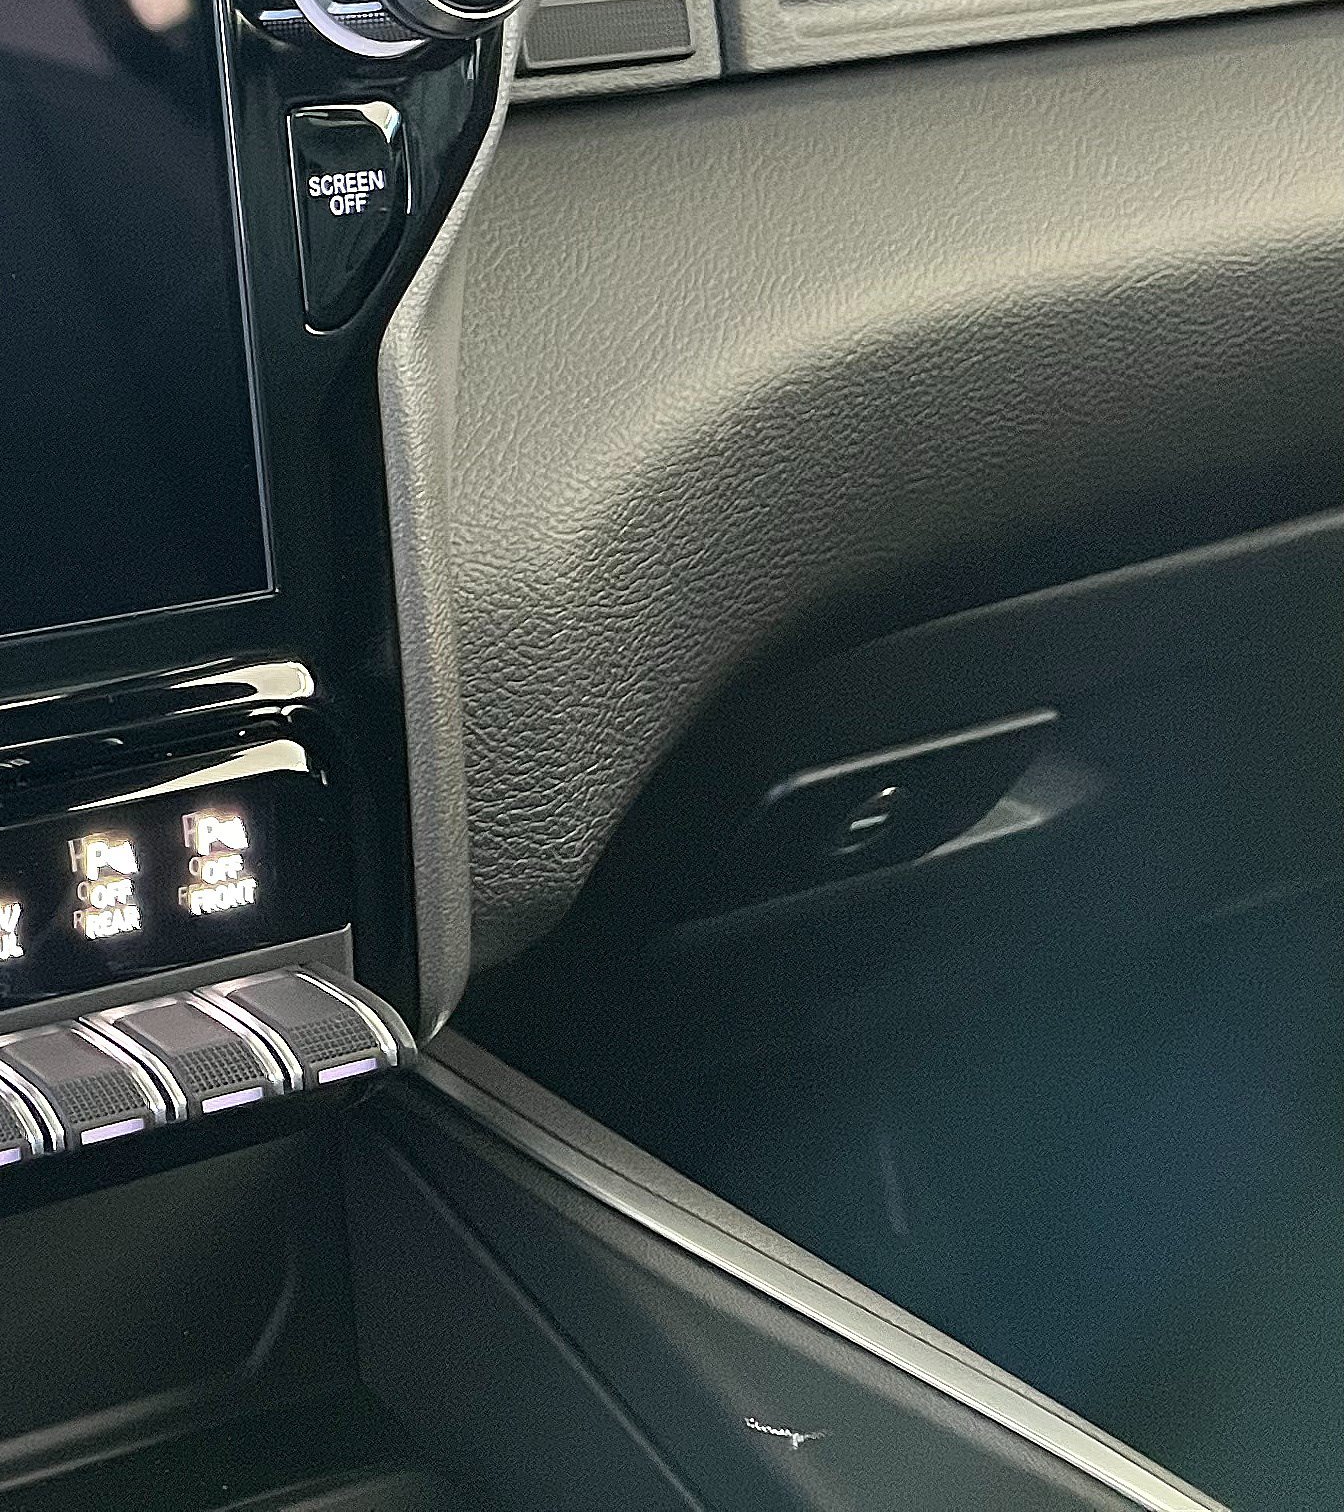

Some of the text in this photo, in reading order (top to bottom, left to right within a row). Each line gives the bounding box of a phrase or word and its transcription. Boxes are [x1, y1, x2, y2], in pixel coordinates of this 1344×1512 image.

[308, 169, 385, 197] SCREEN
[328, 193, 368, 216] OFF
[200, 853, 244, 885] OFF
[88, 878, 133, 909] OFF
[189, 877, 258, 917] FRONT
[85, 904, 142, 940] REAR
